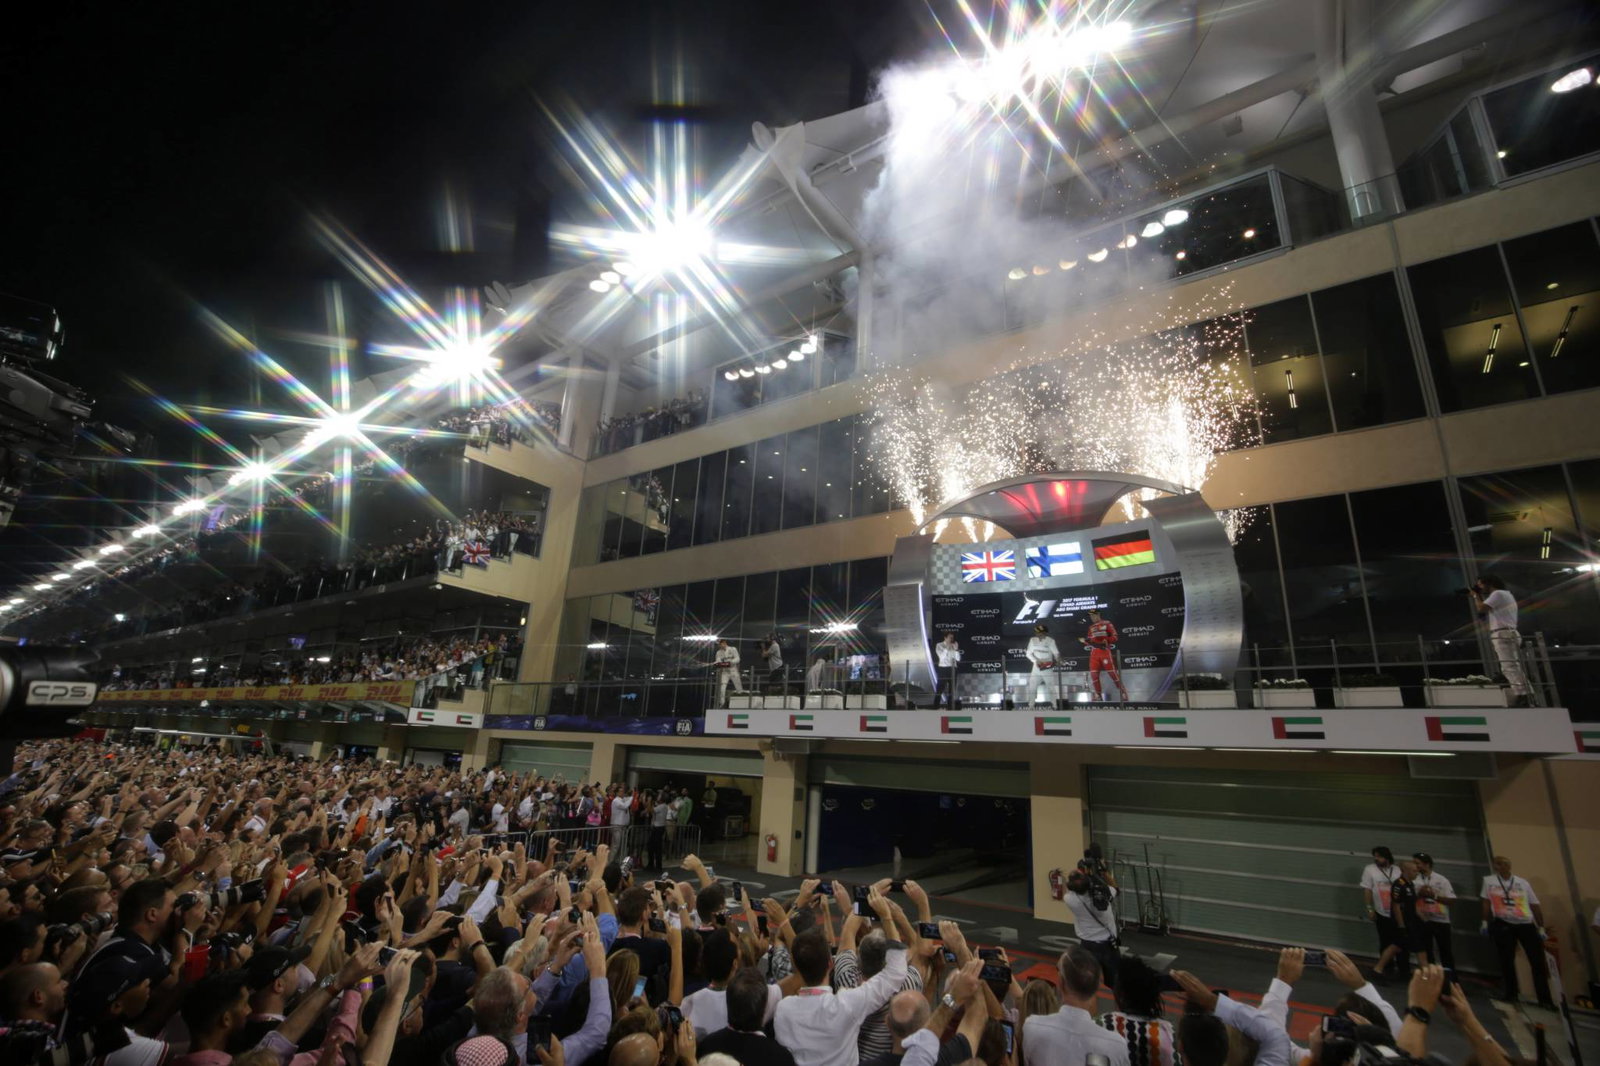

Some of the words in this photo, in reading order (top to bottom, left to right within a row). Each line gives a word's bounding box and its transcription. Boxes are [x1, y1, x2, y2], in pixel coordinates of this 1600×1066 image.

[1158, 576, 1182, 584] ETIHA
[1120, 595, 1152, 604] ETIHAD
[1015, 599, 1057, 620] F1
[1161, 606, 1185, 614] ETIHA
[1122, 625, 1155, 634] ETIHAD
[1124, 655, 1158, 664] ETIHAD
[31, 685, 87, 701] CPS
[279, 688, 303, 697] DHL
[319, 687, 348, 697] DHL
[366, 684, 403, 697] DHL
[676, 722, 691, 732] FIA
